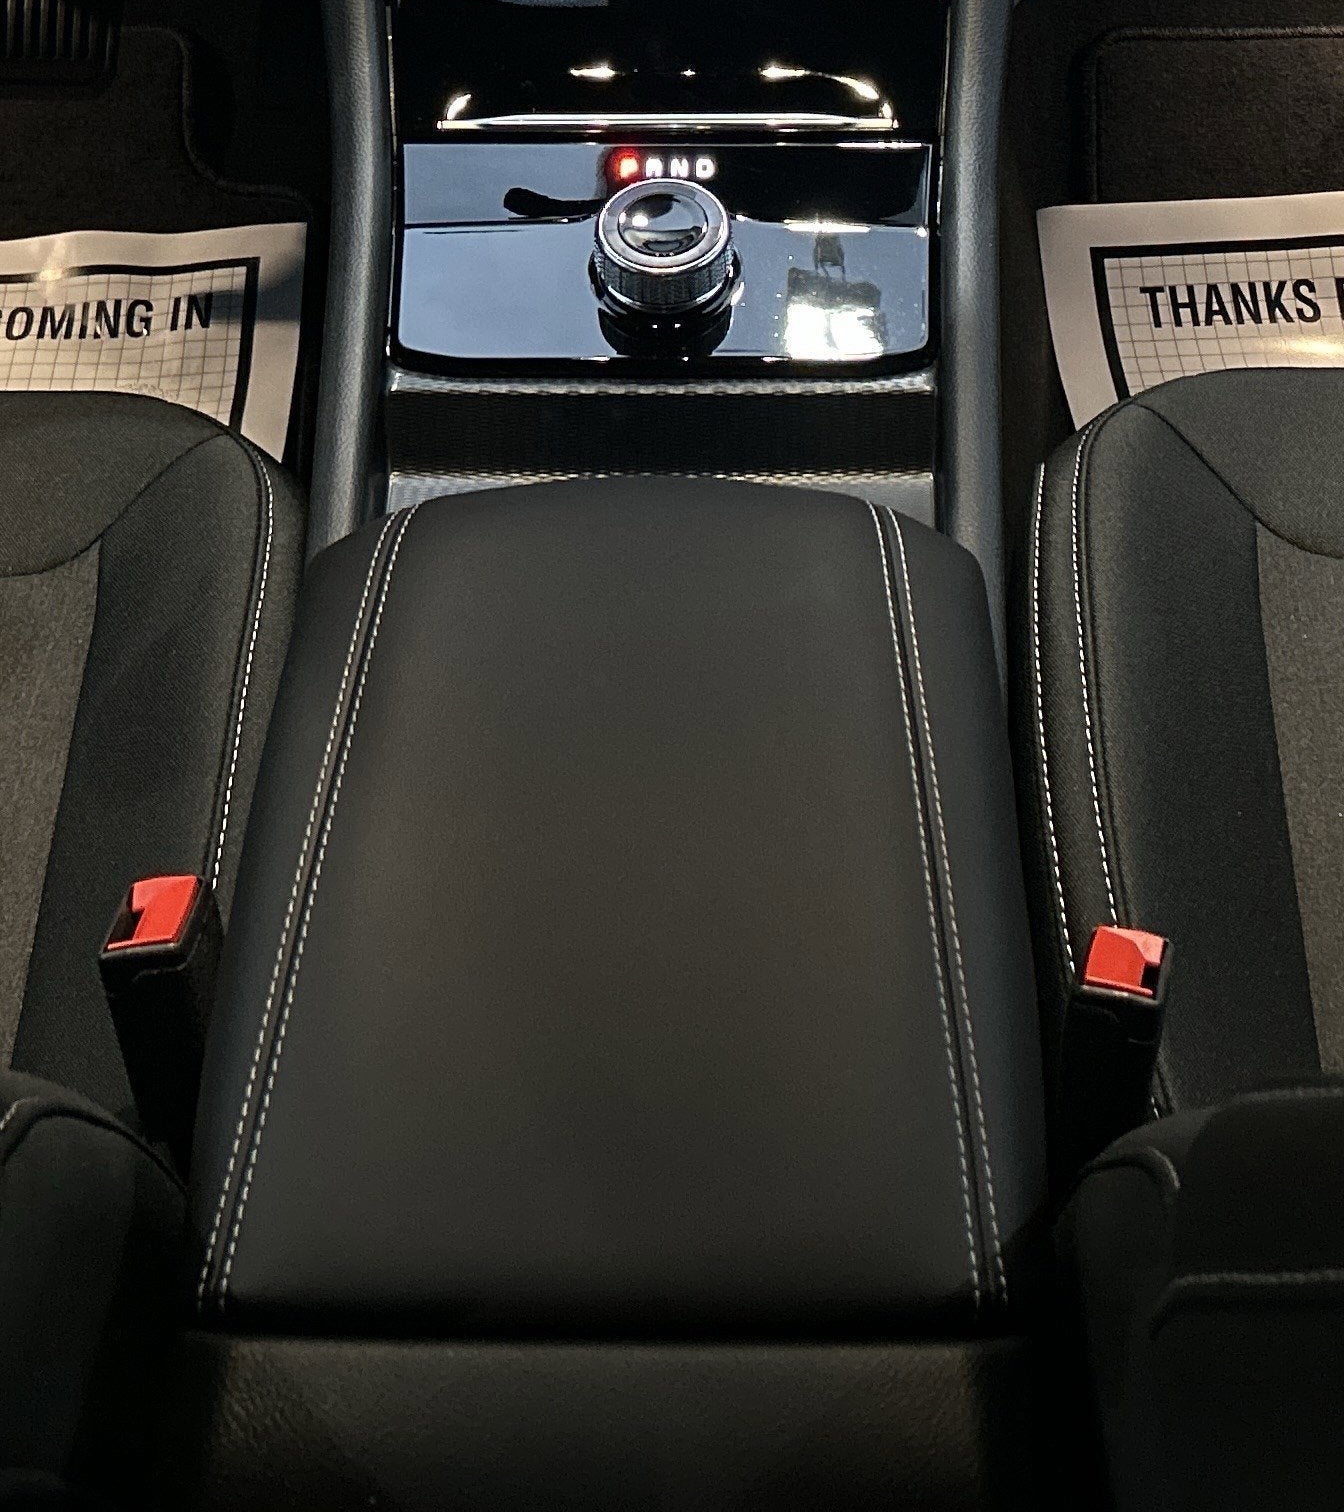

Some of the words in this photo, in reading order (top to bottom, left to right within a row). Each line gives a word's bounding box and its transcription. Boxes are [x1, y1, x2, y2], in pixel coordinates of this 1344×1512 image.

[670, 157, 690, 178] N
[695, 157, 717, 178] D
[169, 293, 213, 332] IN
[1139, 277, 1322, 329] THANKS
